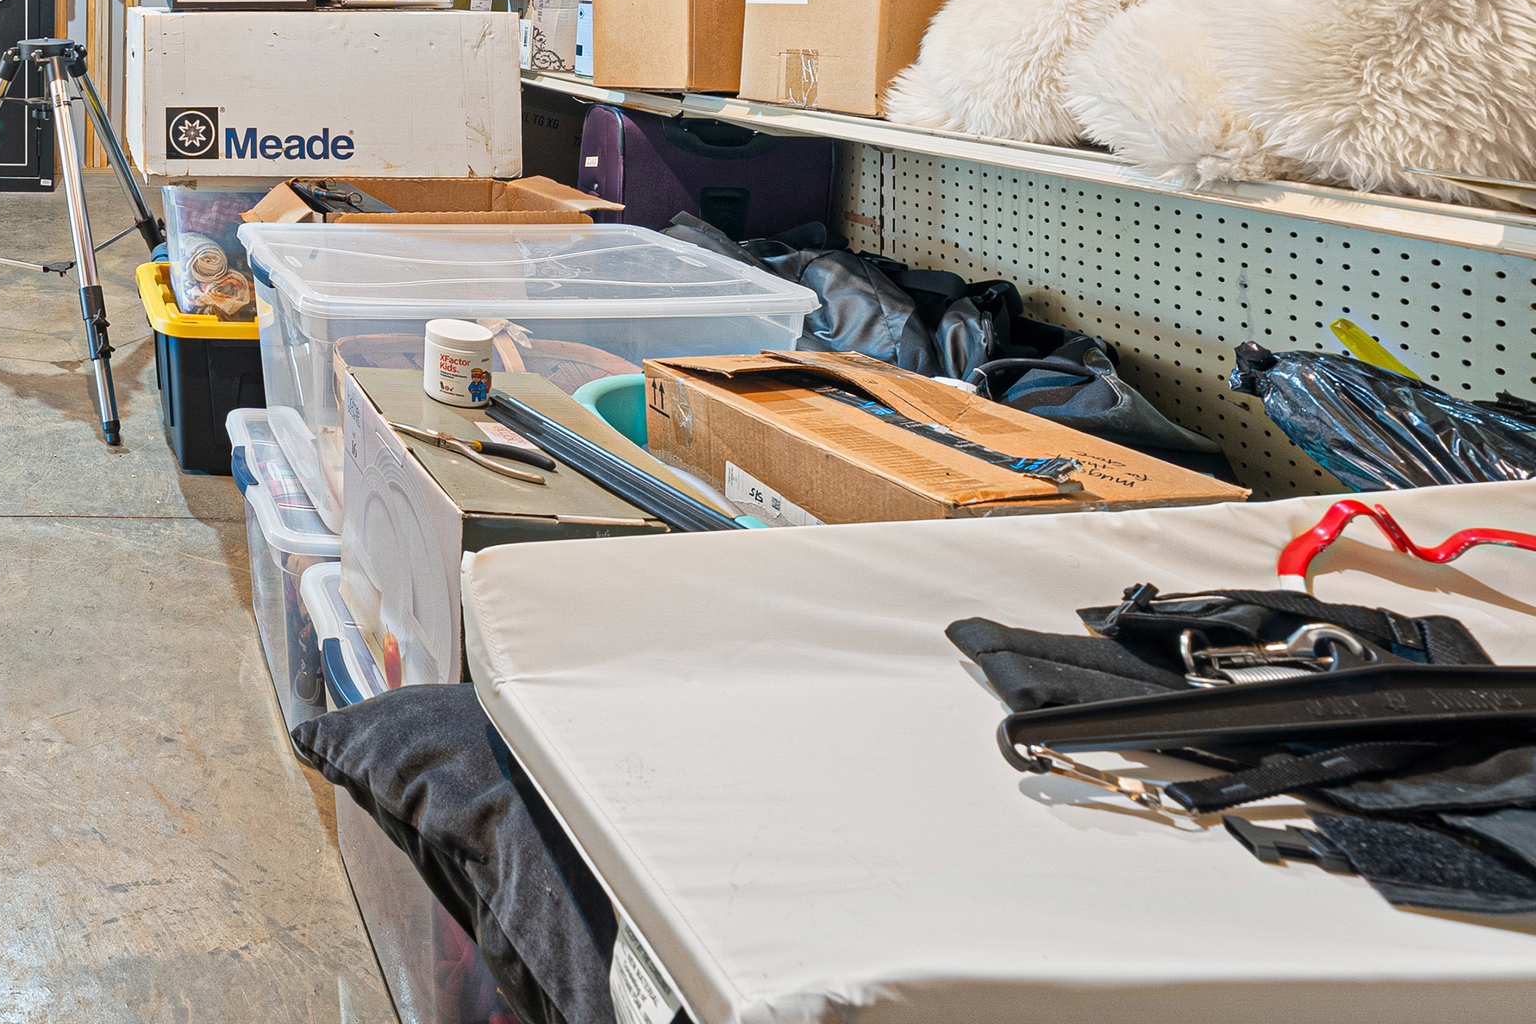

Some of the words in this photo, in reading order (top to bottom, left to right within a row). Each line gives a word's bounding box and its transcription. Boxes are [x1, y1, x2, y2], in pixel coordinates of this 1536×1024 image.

[533, 114, 545, 126] TG
[546, 118, 559, 129] XG
[225, 128, 354, 160] Meade
[440, 354, 471, 366] XFactor
[440, 362, 457, 372] Kids
